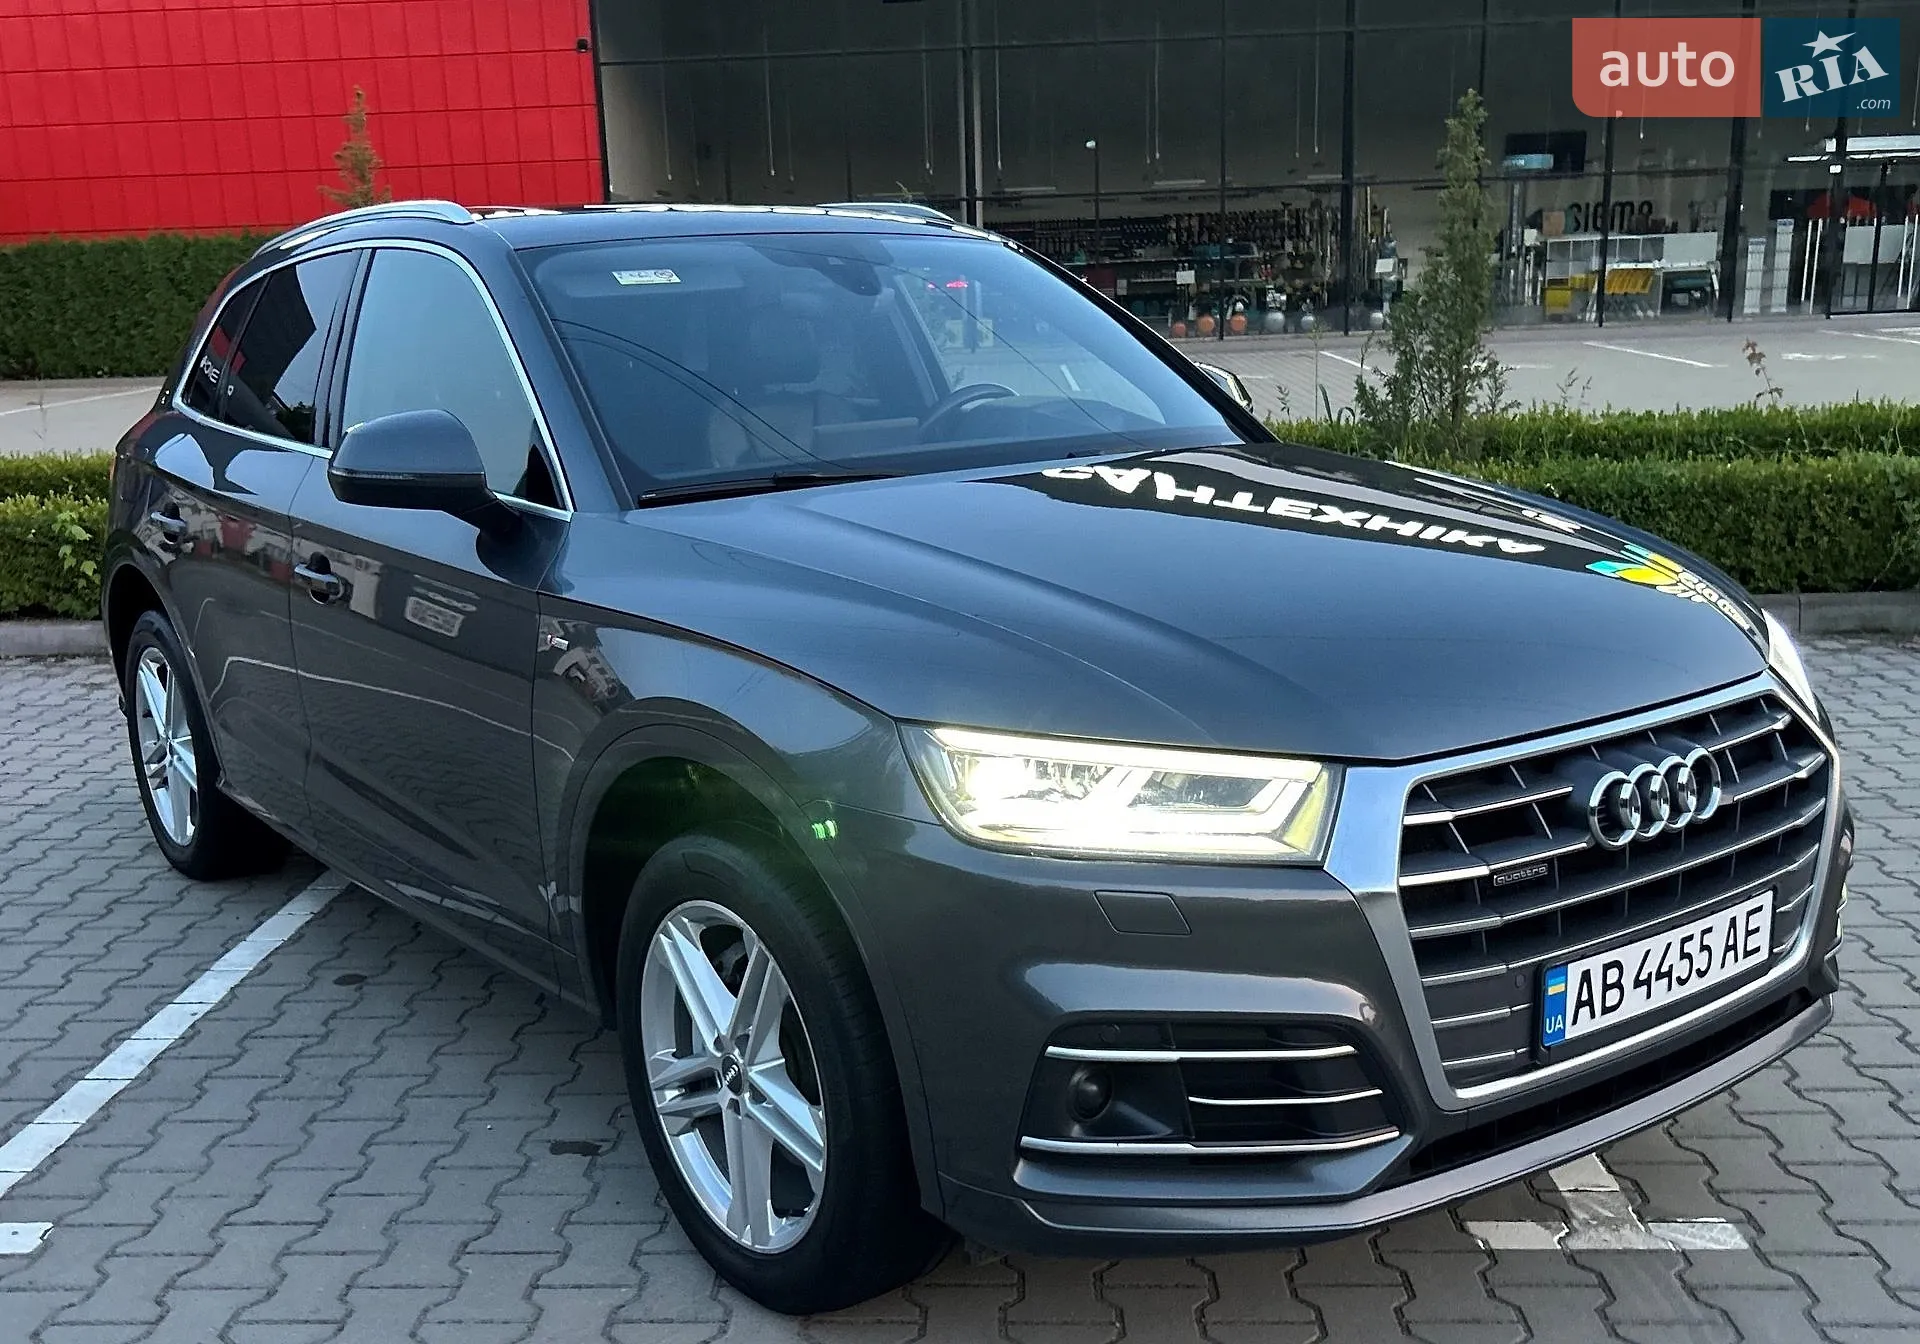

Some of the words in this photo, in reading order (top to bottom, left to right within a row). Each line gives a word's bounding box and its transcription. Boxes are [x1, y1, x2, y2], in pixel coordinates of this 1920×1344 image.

[1496, 866, 1546, 885] quattro
[1571, 959, 1625, 1026] AB
[1632, 926, 1714, 1000] 4455
[1720, 904, 1764, 970] AE
[1545, 1014, 1564, 1034] UA
